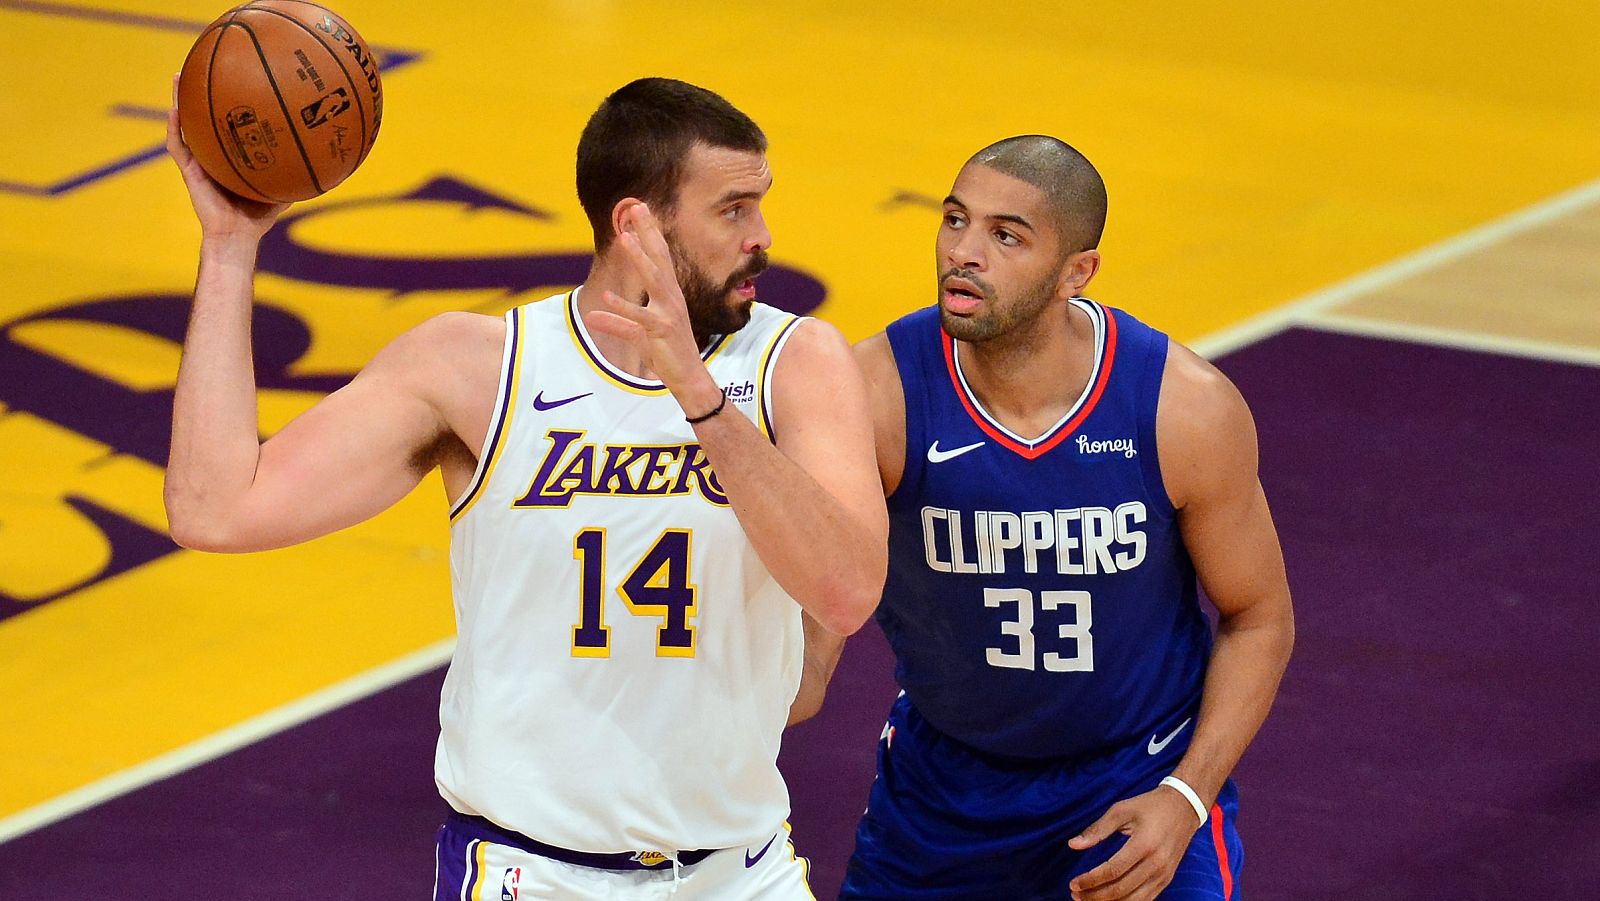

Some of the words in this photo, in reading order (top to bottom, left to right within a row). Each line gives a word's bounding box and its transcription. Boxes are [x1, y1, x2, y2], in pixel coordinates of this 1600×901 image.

[511, 428, 731, 509] LAKER
[1075, 434, 1137, 459] honey
[921, 501, 1147, 574] CLIPPERS
[571, 526, 698, 658] 14
[984, 588, 1094, 672] 33
